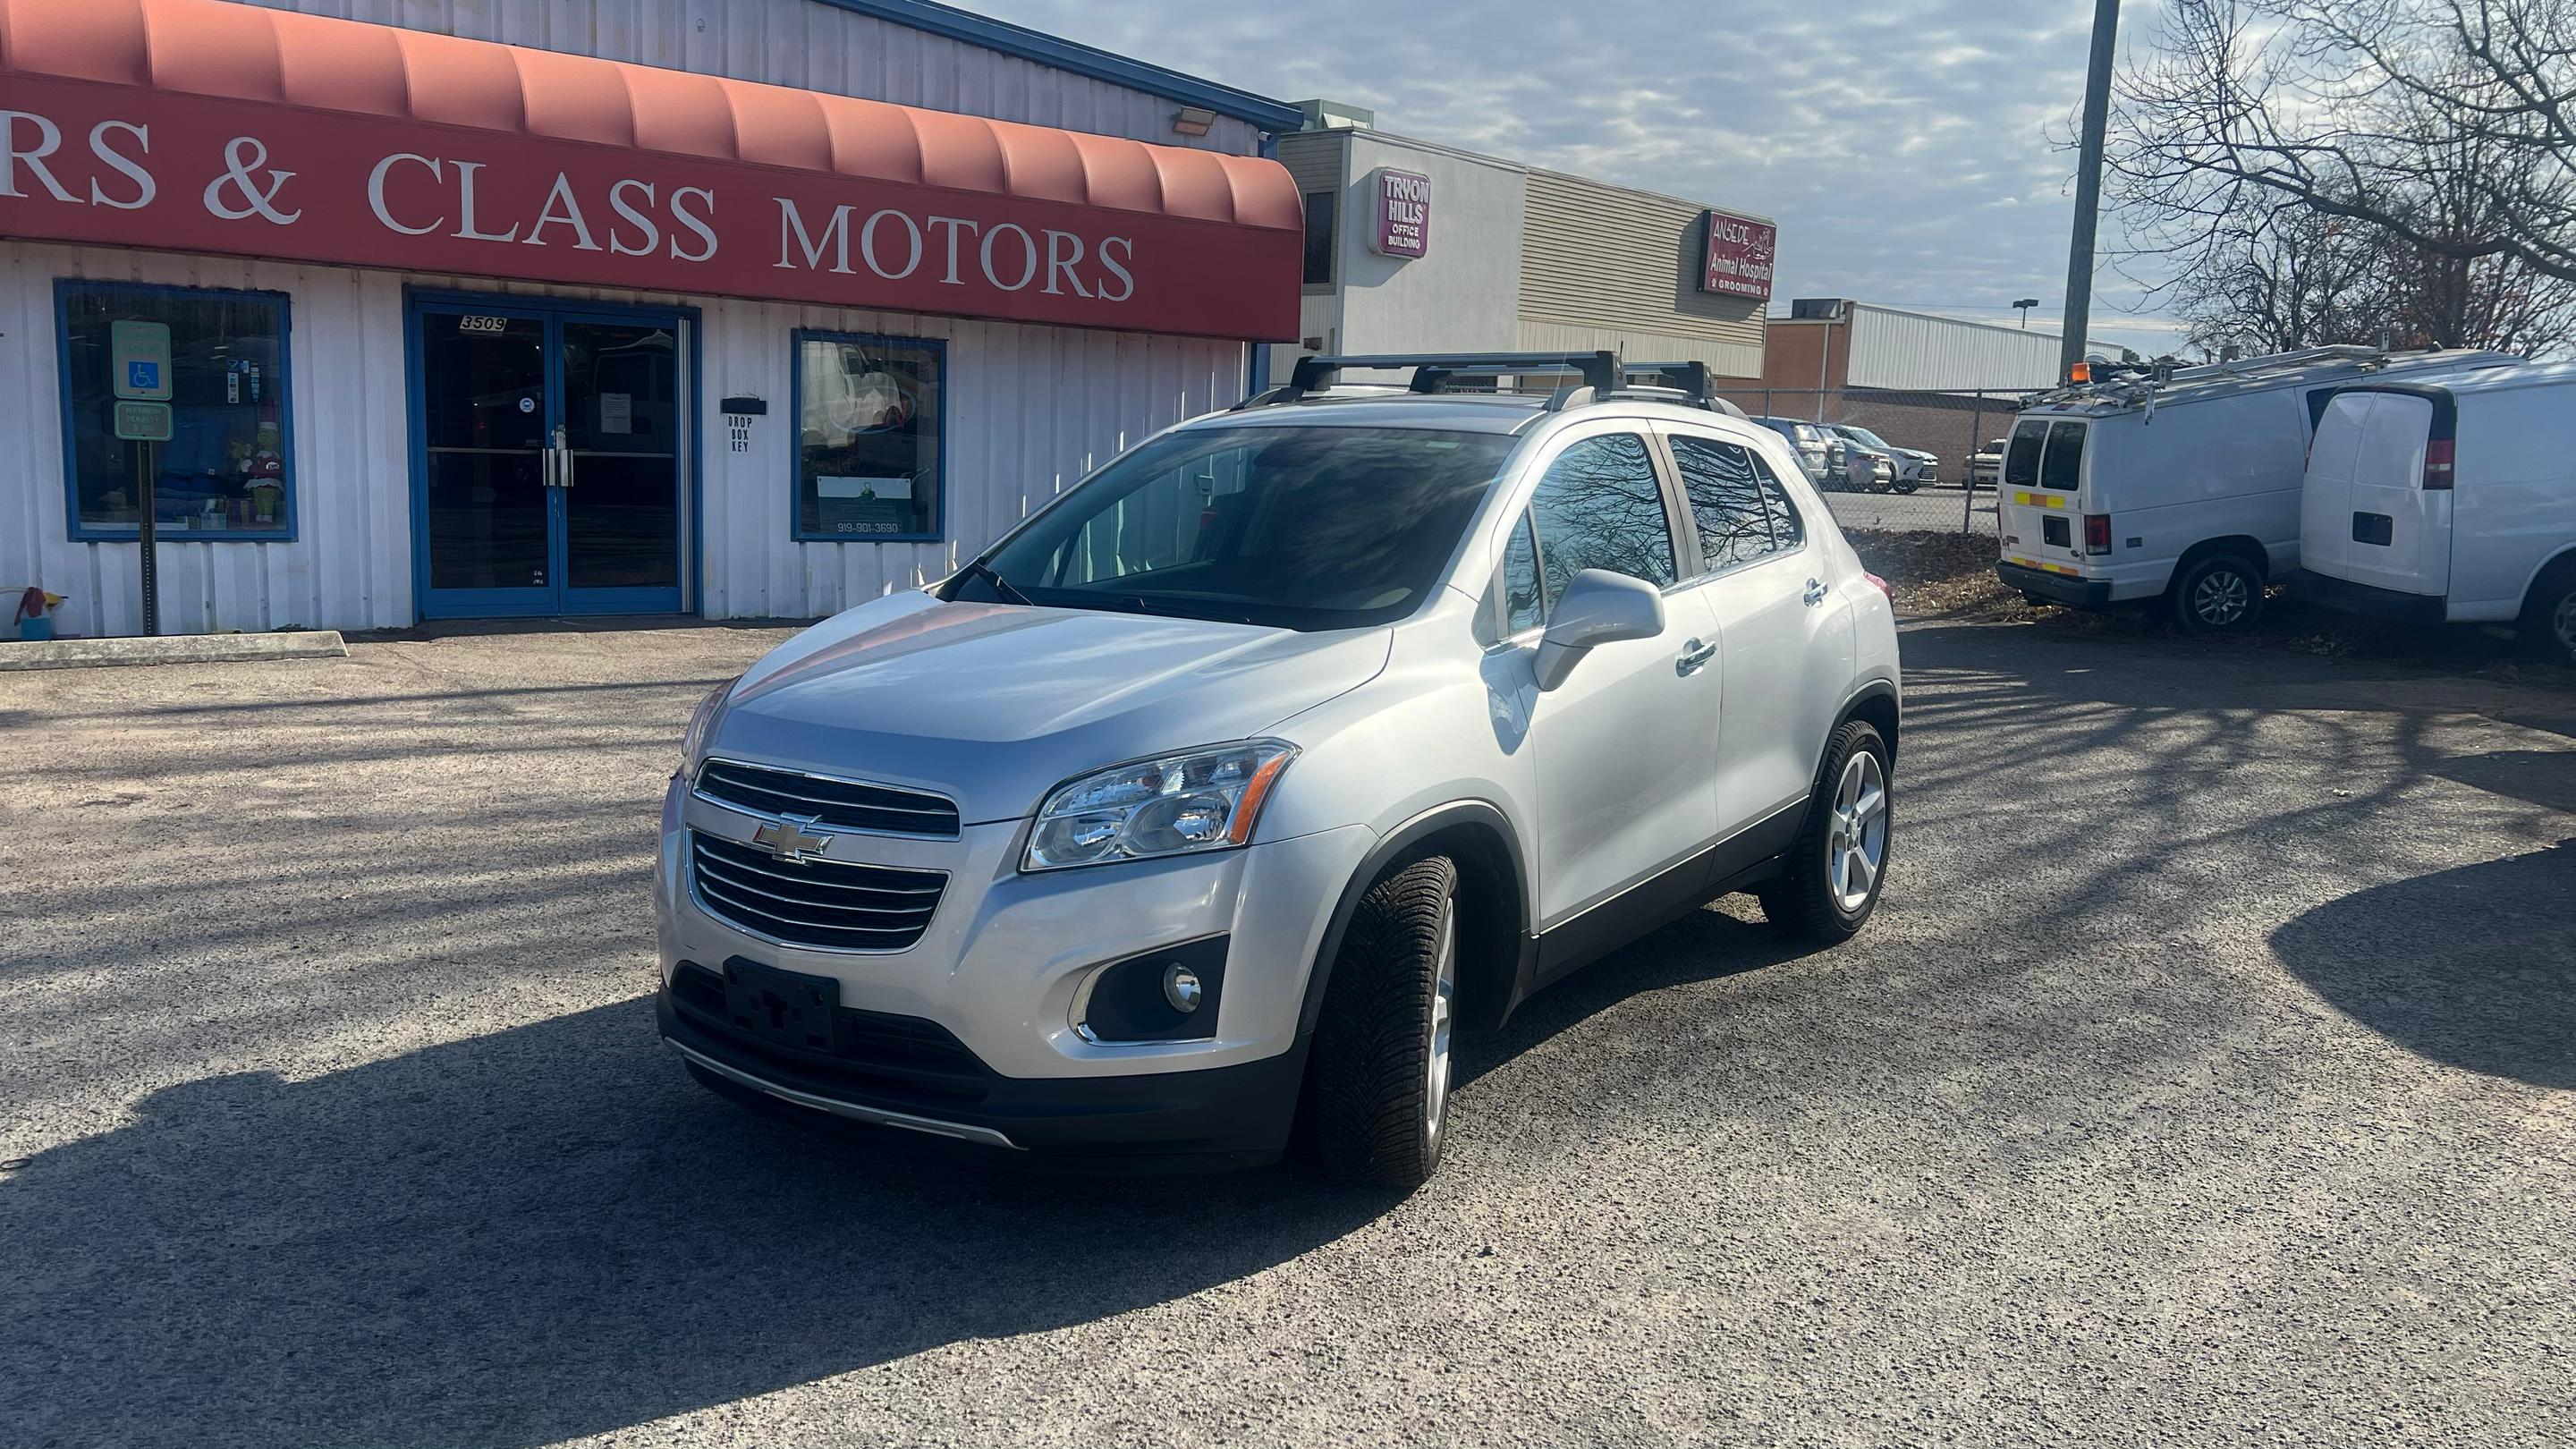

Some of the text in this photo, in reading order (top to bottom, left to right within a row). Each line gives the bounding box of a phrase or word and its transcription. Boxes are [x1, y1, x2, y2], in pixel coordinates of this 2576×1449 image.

[1385, 175, 1428, 204] TRYON
[0, 110, 1134, 301] RS & CLASS MOTORS
[1388, 200, 1423, 225] HILLS
[1392, 224, 1419, 237] OFFICE
[1387, 236, 1420, 250] BUILDING
[1710, 252, 1772, 283] Animal Hospital
[1718, 279, 1762, 295] GROOMING
[462, 316, 504, 330] 3509
[728, 416, 752, 428] DROP
[732, 429, 749, 440] BOX
[732, 441, 749, 453] KEY
[837, 522, 898, 533] 919-901-3690
